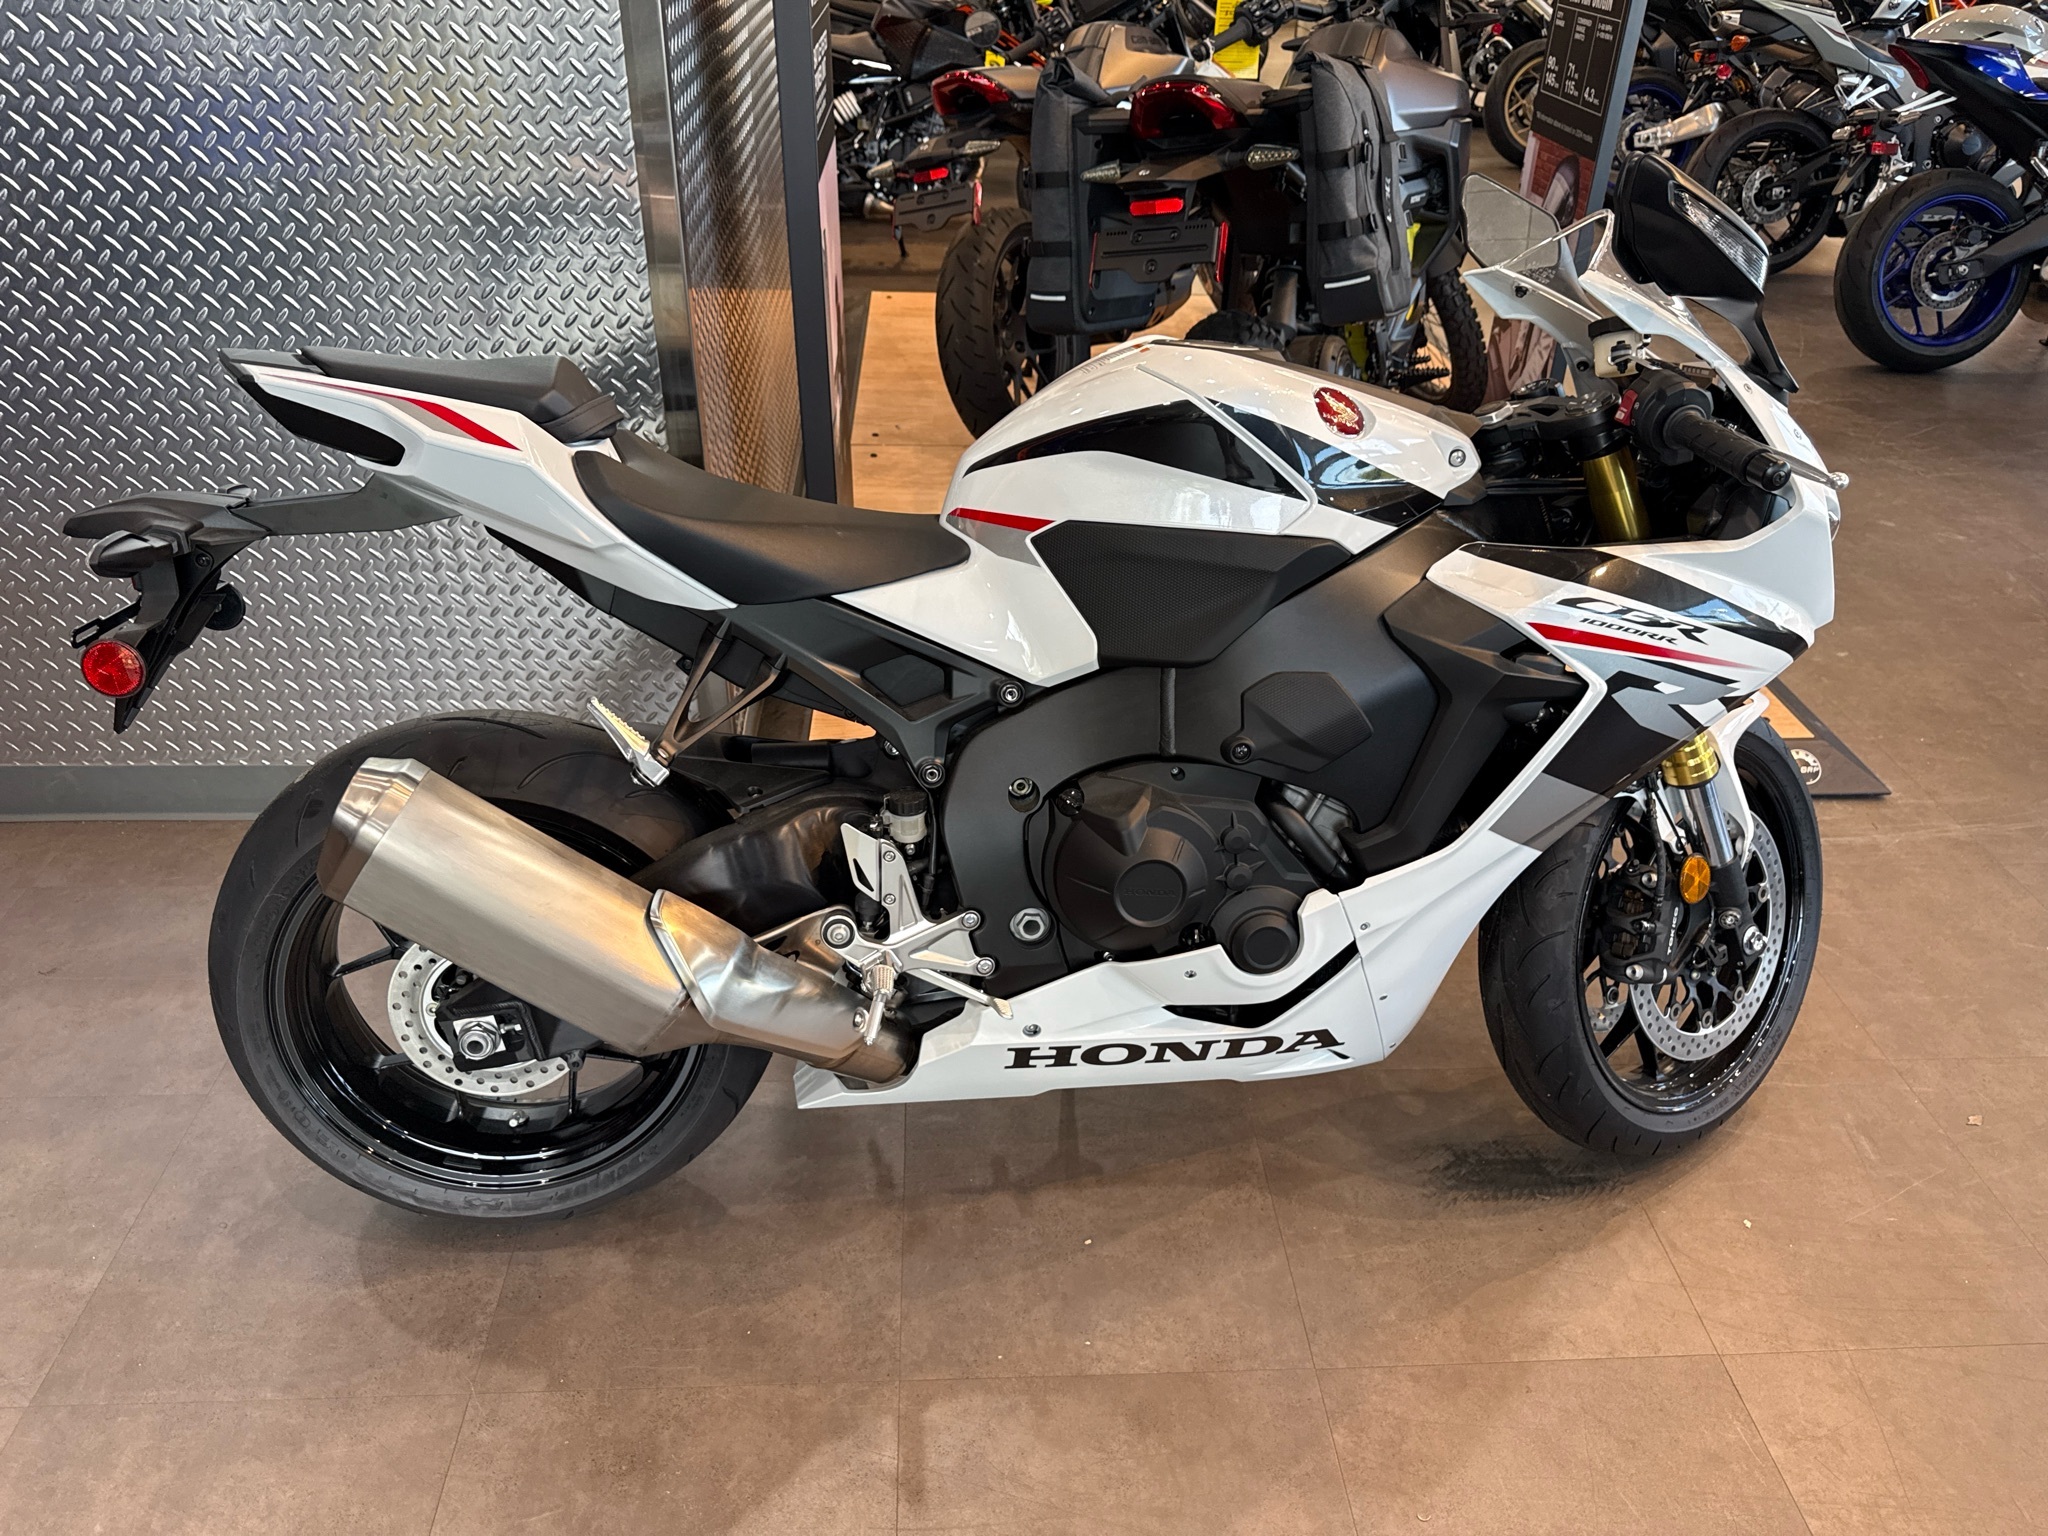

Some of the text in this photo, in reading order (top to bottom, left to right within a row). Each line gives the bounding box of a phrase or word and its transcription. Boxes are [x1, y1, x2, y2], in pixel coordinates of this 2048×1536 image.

[1547, 55, 1556, 70] 90
[1567, 62, 1576, 78] 71
[1545, 71, 1556, 87] 145
[1564, 79, 1576, 95] 115
[1583, 86, 1595, 103] 4.3
[1556, 597, 1709, 645] CBR
[1579, 617, 1678, 646] 1000RR
[1667, 906, 1679, 956] TOKICO
[1004, 1028, 1346, 1069] HONDA
